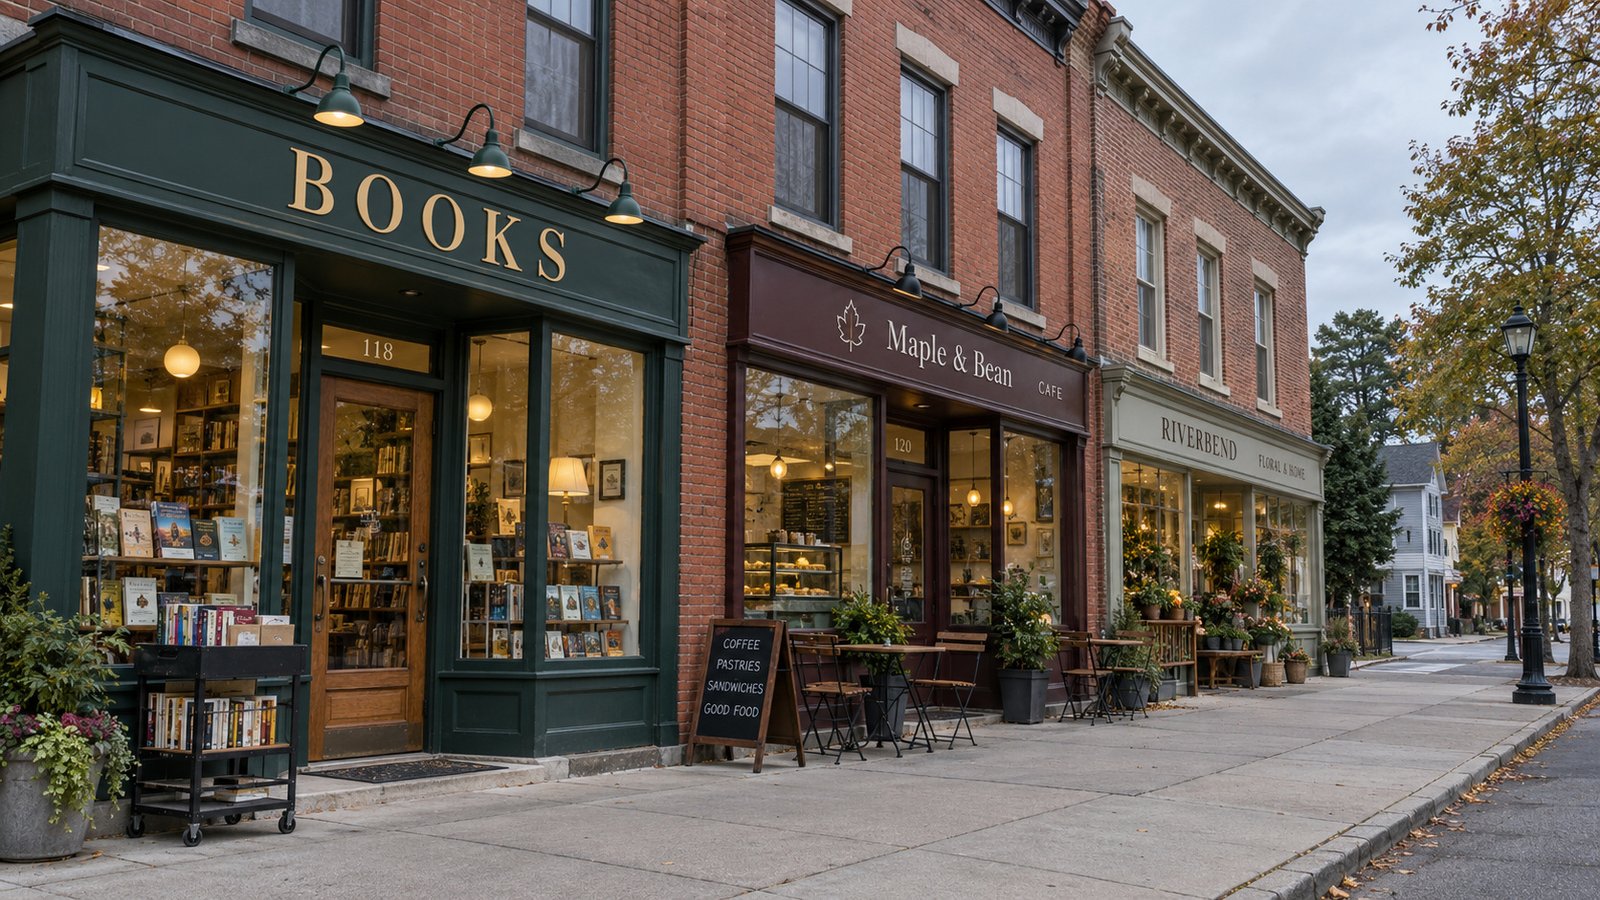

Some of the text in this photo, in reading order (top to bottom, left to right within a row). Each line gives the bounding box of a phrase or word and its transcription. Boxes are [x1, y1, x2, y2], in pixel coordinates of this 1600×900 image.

[287, 147, 566, 282] BOOKS
[363, 338, 393, 361] 118
[886, 319, 1013, 388] Maple & Bean
[1038, 380, 1063, 401] CAFE
[895, 437, 912, 453] 120
[1161, 416, 1237, 461] RIVERBEND
[1258, 454, 1281, 473] FLORAL
[723, 638, 760, 650] COFFEE
[716, 658, 760, 672] PASTRIES
[707, 680, 764, 695] SANDWICHES
[703, 702, 759, 718] GOOD FOOD
